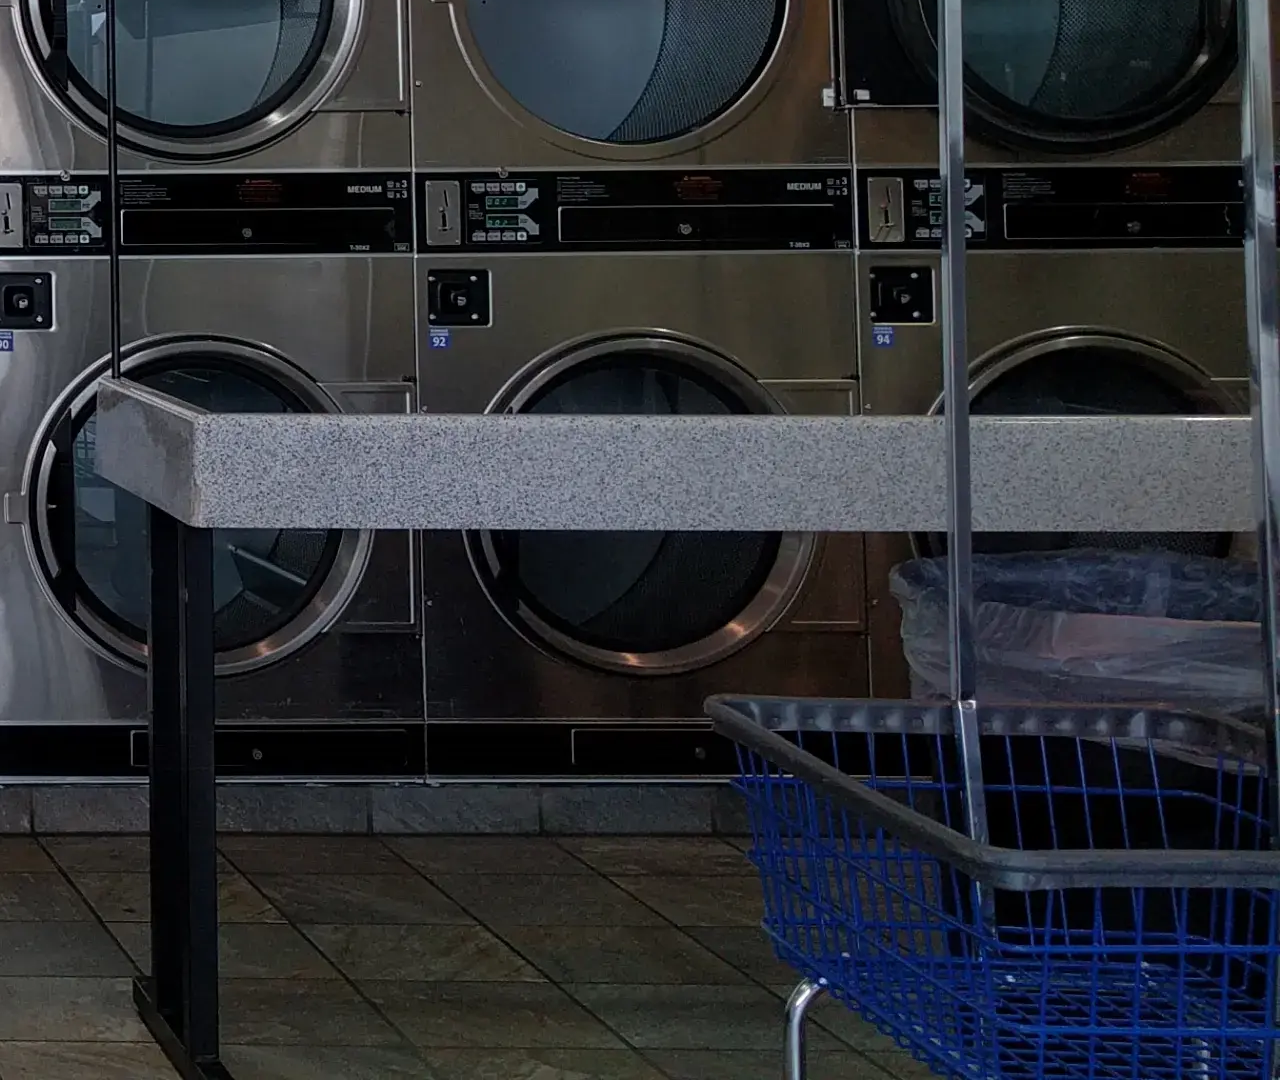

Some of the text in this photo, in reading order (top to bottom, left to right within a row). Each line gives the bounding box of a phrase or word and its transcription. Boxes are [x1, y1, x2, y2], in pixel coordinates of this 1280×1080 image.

[347, 185, 382, 193] MEDIUM
[786, 182, 822, 191] MEDIUM
[432, 337, 446, 346] 92
[876, 335, 890, 344] 94
